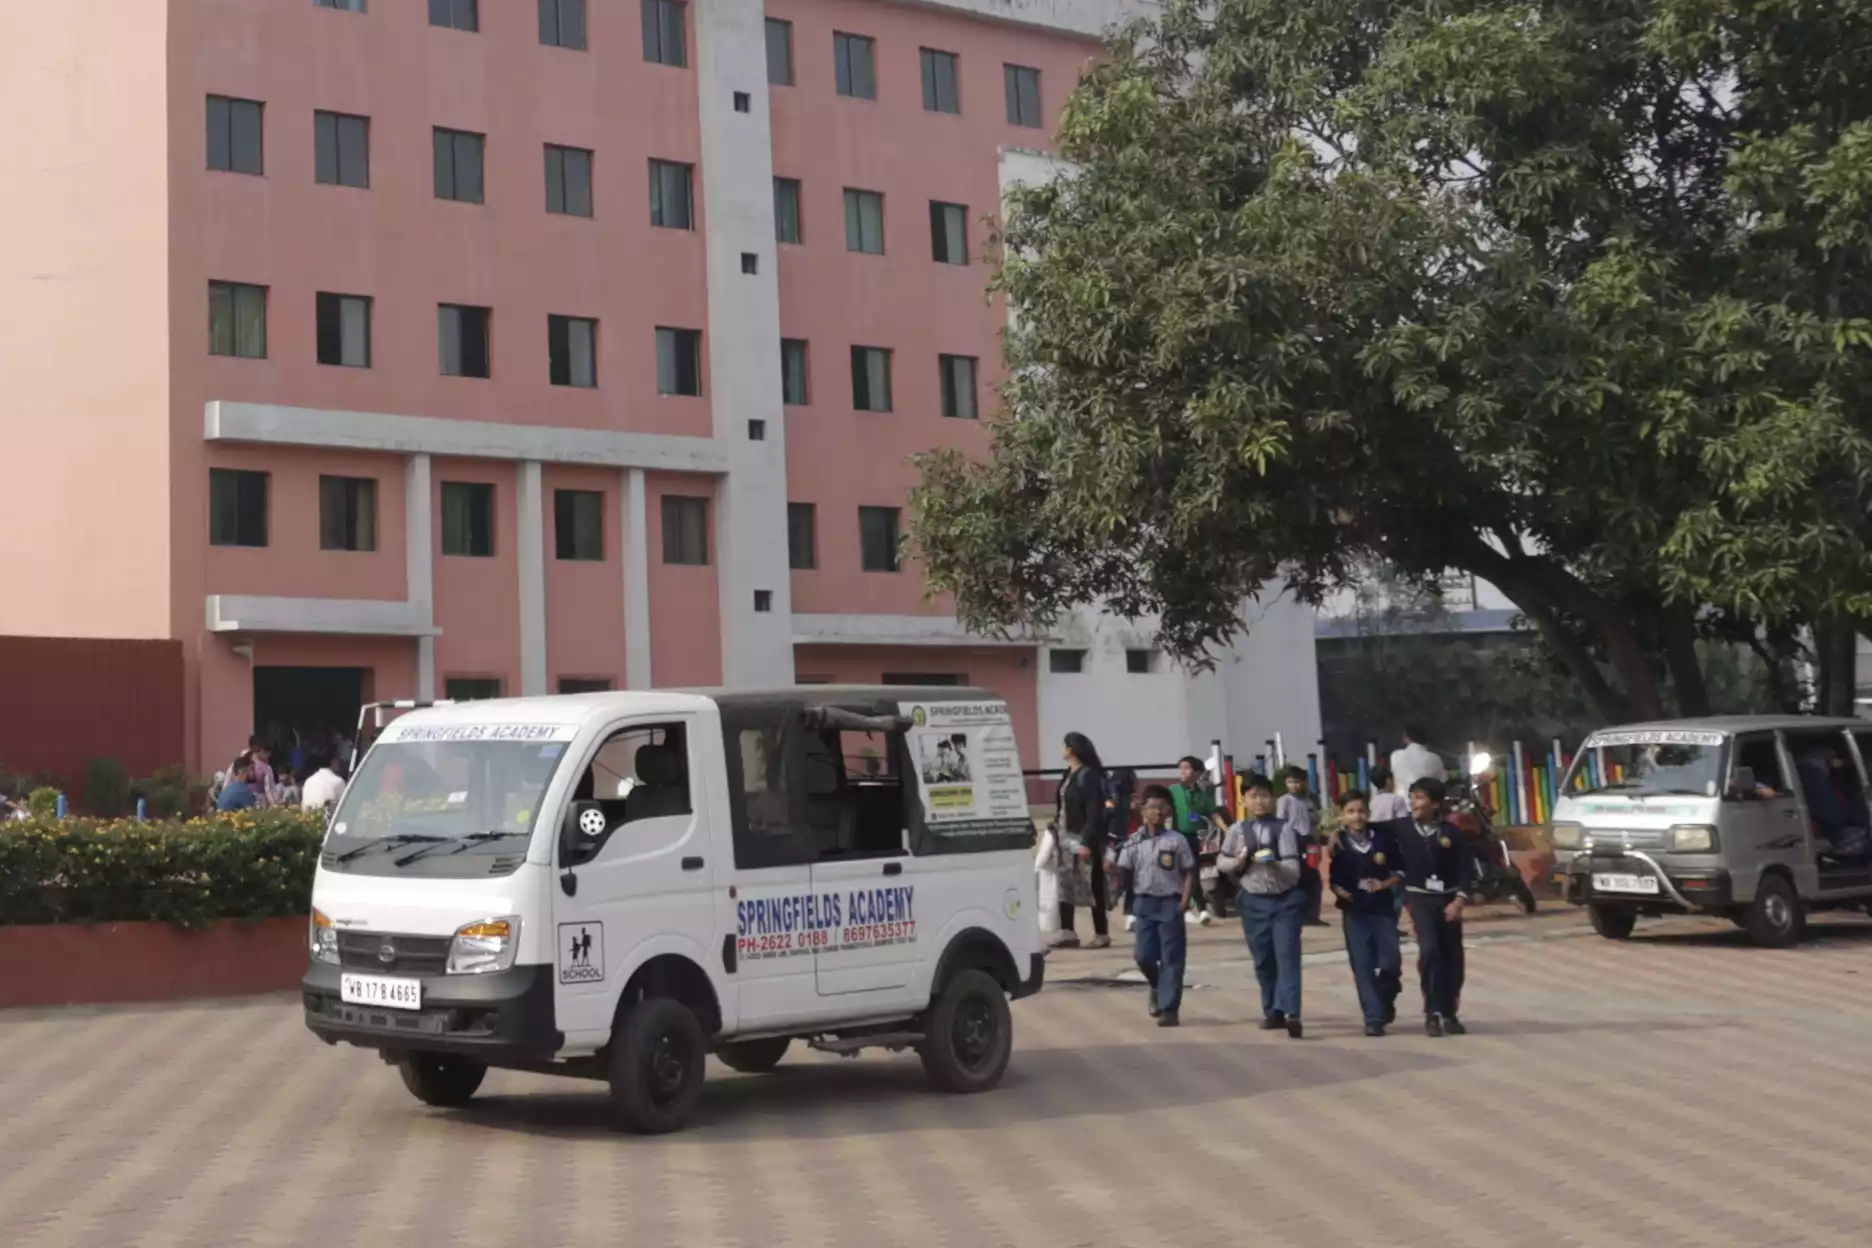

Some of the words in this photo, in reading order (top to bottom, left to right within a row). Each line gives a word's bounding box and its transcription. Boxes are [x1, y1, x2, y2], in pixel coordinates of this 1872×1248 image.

[930, 705, 984, 716] SPRINGFIELDS
[397, 726, 487, 741] SPRINGFIELDS
[490, 725, 560, 740] ACADEMY
[738, 892, 841, 936] SPRINGFIELDS
[849, 886, 914, 925] ACADEMY
[738, 934, 792, 953] PH-2622
[798, 930, 828, 947] 0188
[843, 920, 916, 943] 8697635377
[563, 968, 602, 980] SCHOOL
